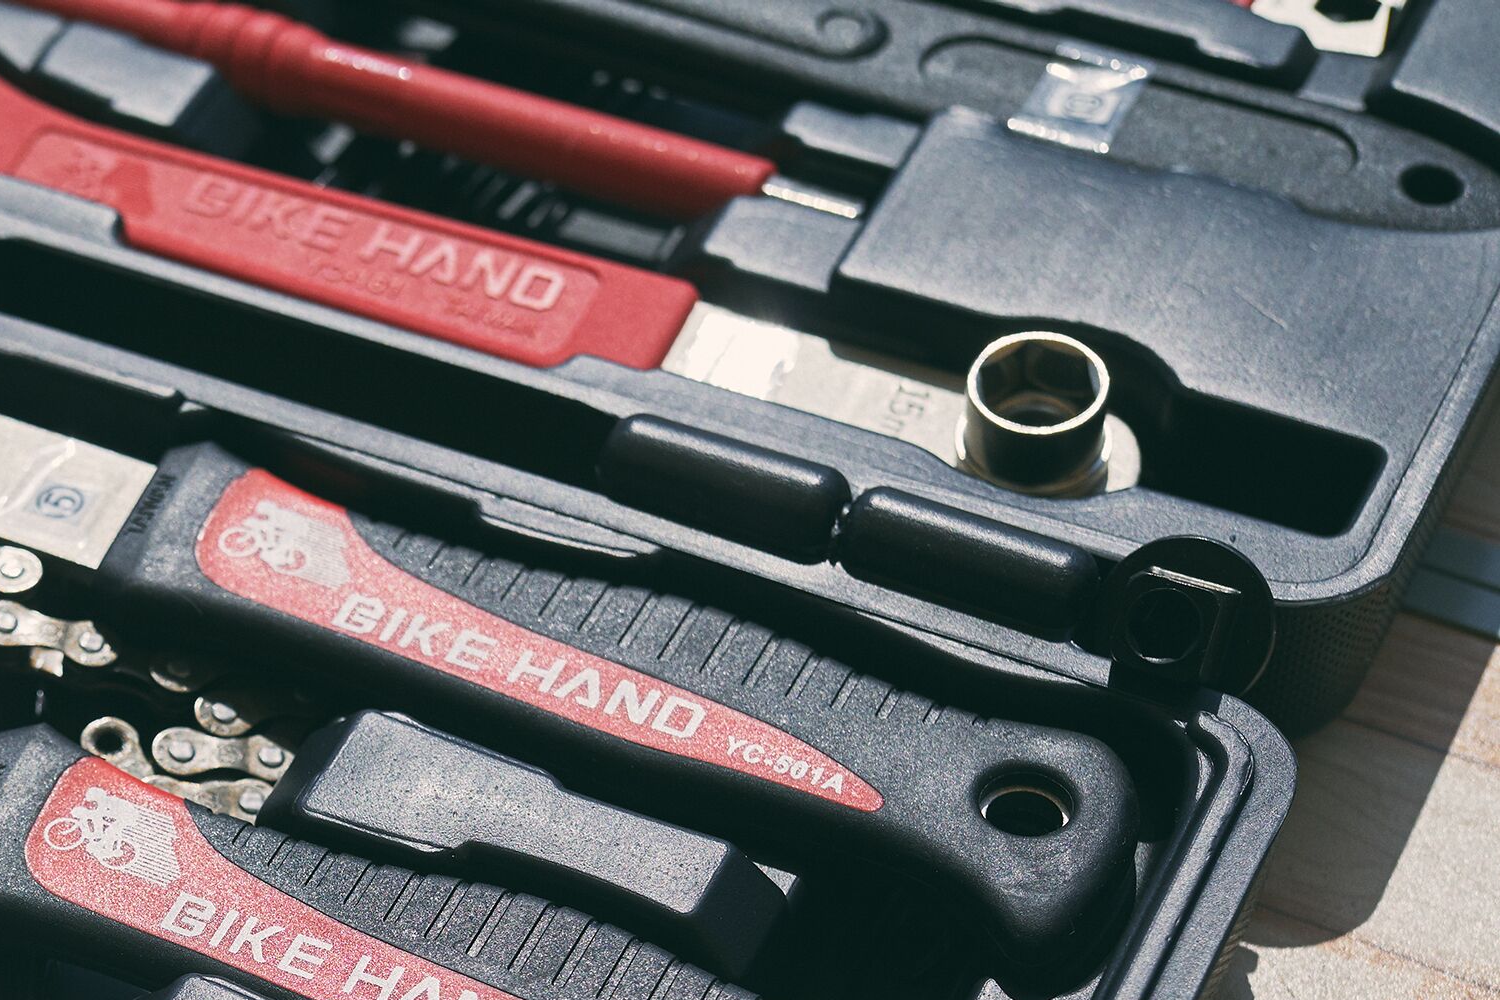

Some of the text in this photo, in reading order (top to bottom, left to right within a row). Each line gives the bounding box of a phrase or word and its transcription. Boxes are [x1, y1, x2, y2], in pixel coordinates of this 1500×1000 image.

[185, 173, 567, 312] BIKE HAND
[331, 593, 498, 673] BIKE
[508, 649, 708, 740] HAND
[159, 893, 332, 979] BIKE
